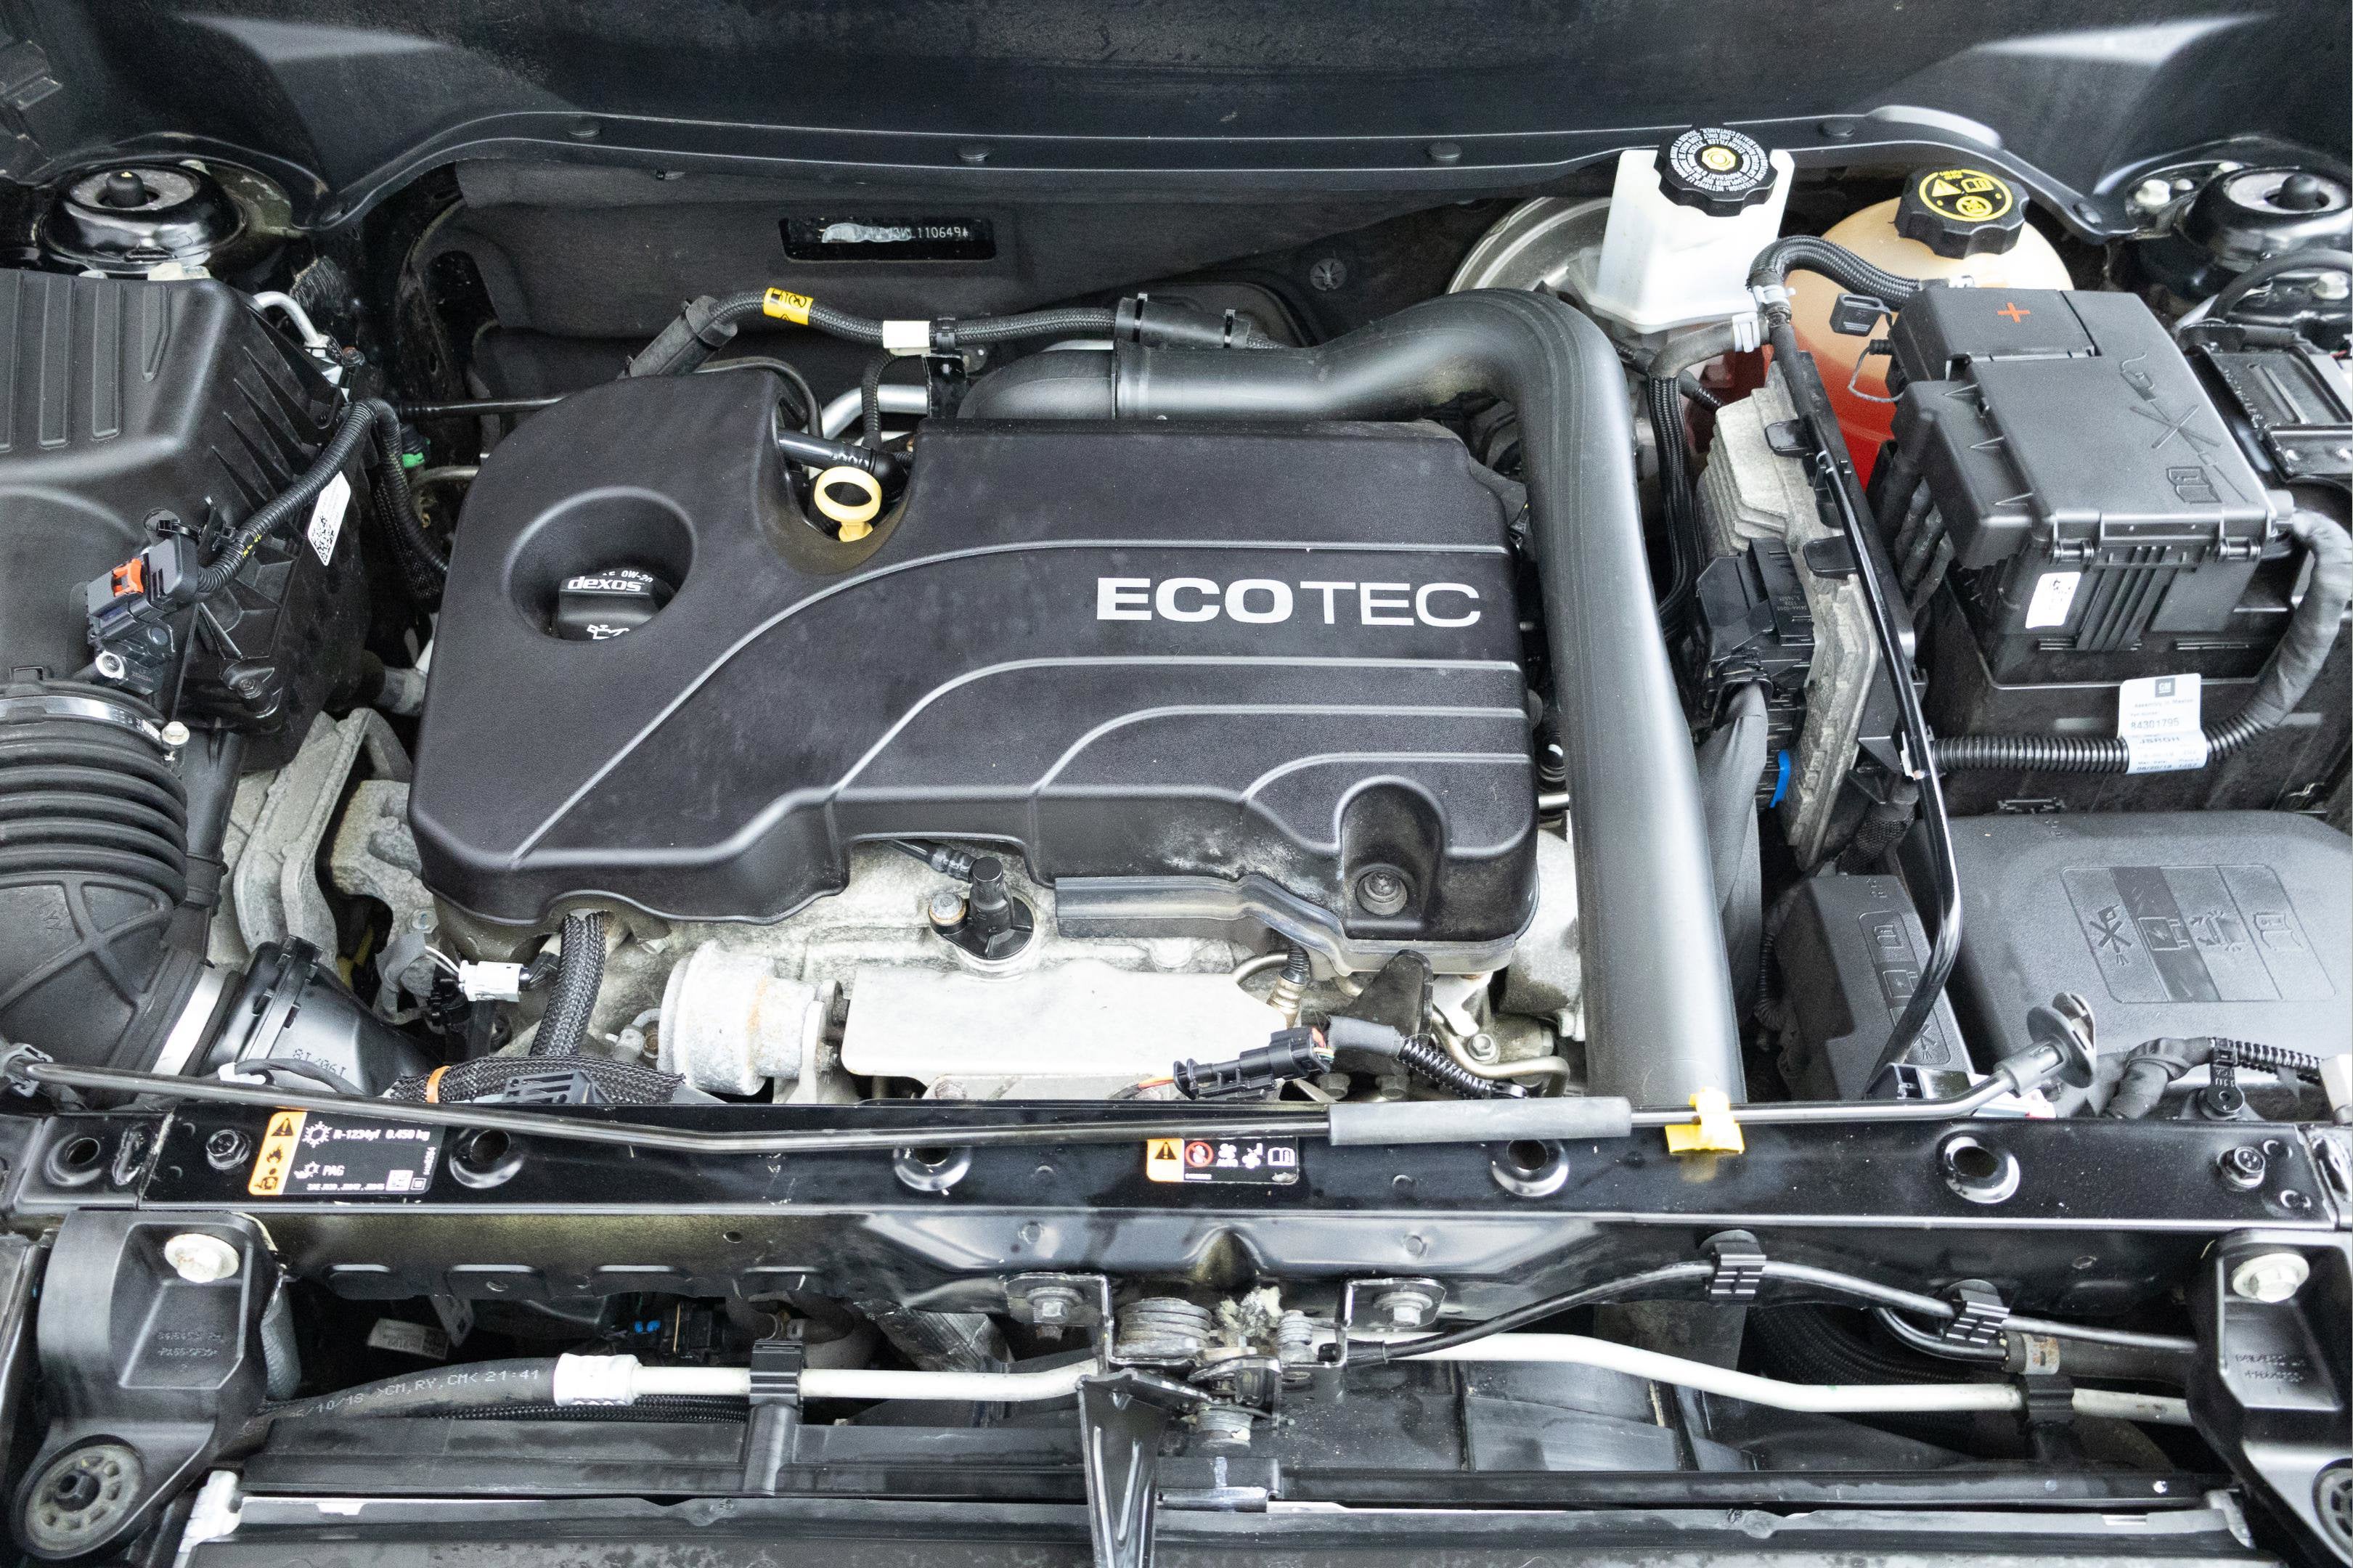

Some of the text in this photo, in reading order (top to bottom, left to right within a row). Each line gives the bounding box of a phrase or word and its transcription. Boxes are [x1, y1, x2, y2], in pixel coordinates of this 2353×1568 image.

[1699, 128, 1736, 137] CONTAINER.
[1734, 132, 1756, 146] SEALED
[1726, 141, 1746, 154] CLEAN
[1692, 179, 1724, 192] NETTOYER
[1725, 178, 1759, 192] ATTENTION:
[568, 576, 642, 592] dexos
[1096, 576, 1482, 628] ECOTEC
[416, 1129, 431, 1141] kg
[322, 1164, 346, 1177] PAG
[484, 1369, 539, 1383] 21:41
